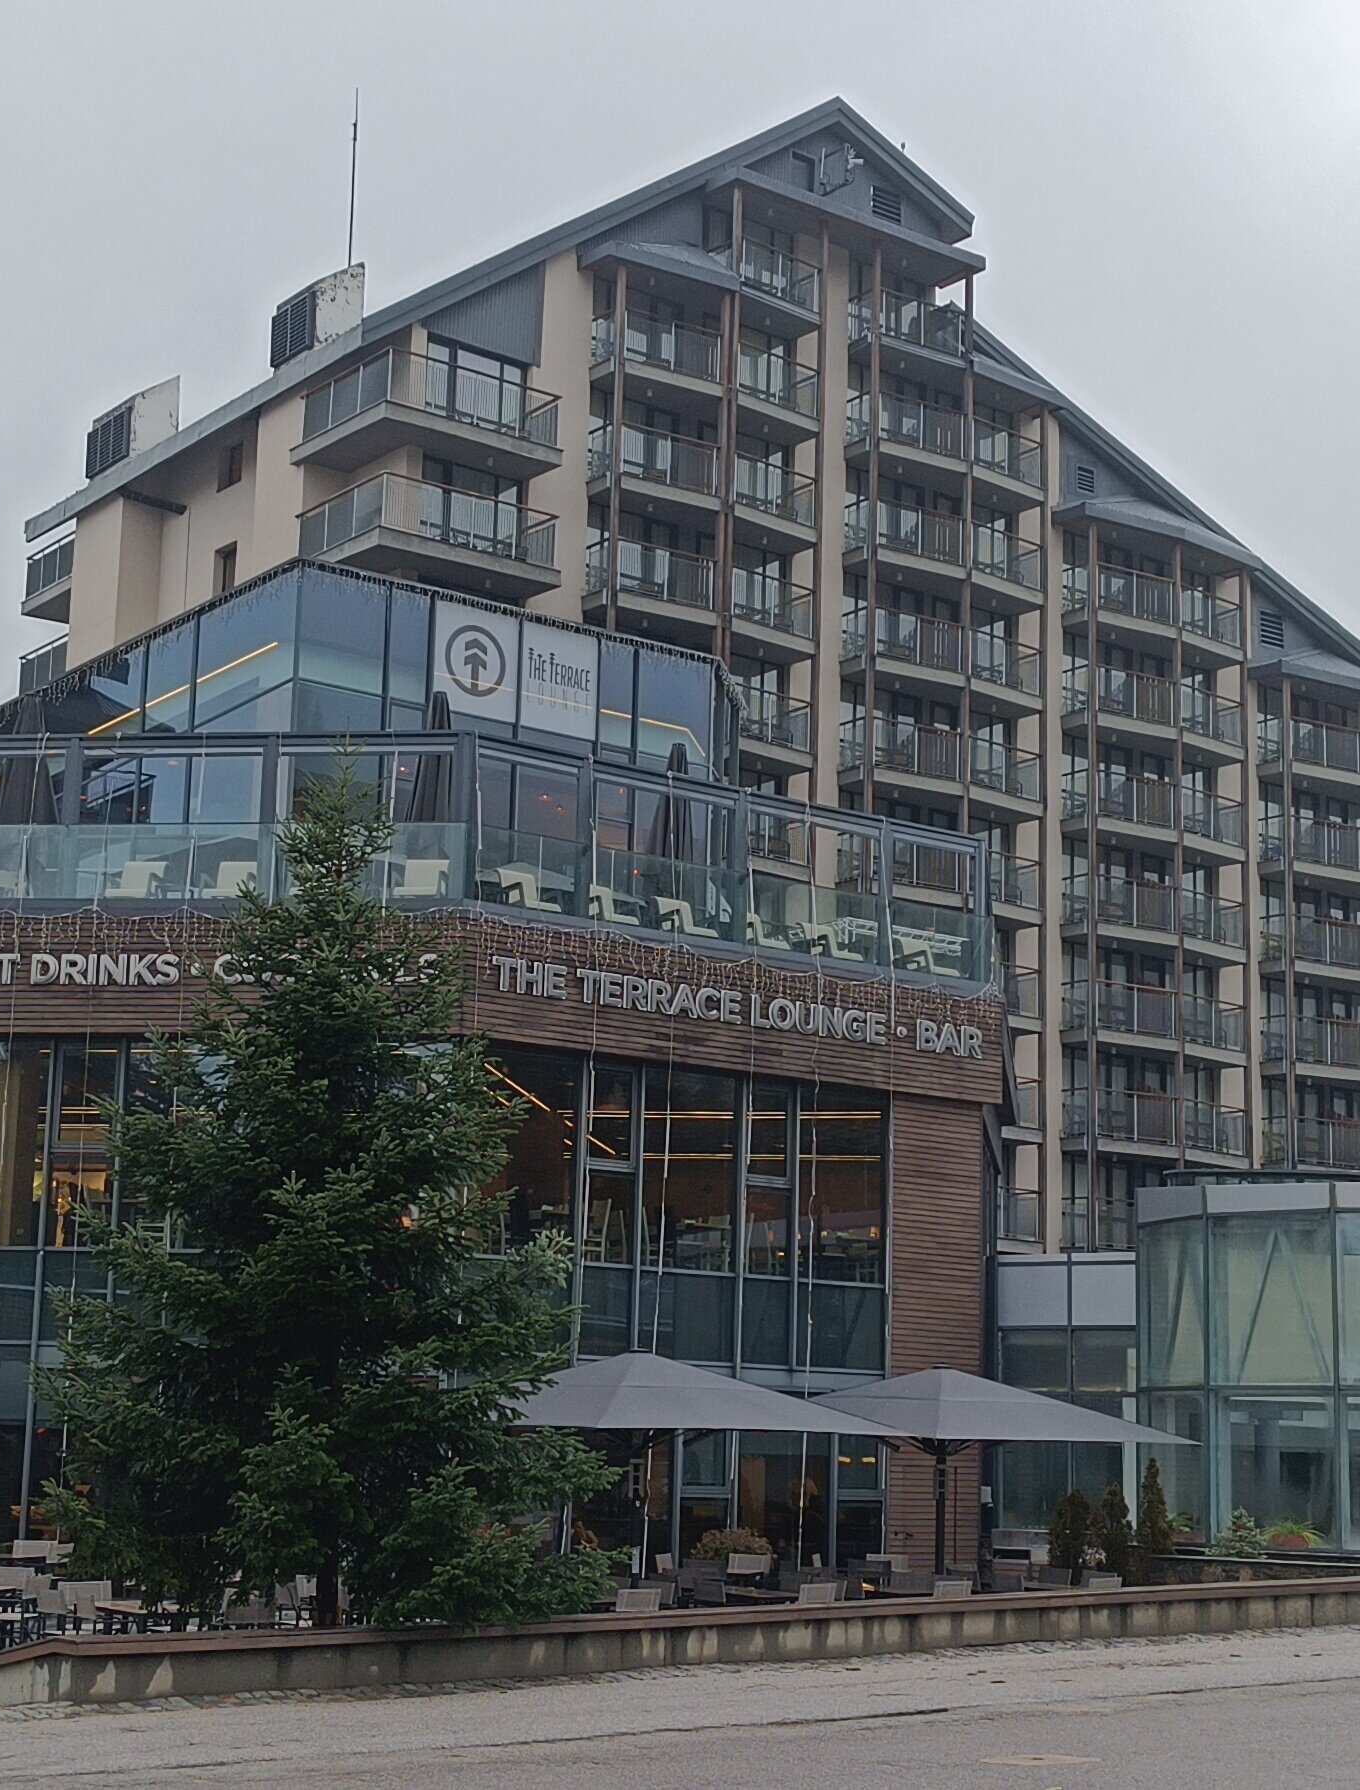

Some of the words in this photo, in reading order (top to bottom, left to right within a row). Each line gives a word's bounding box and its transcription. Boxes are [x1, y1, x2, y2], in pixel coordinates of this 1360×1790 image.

[528, 647, 548, 682] THE
[549, 652, 592, 692] TERRACE
[526, 679, 592, 717] LOUNGE
[30, 953, 180, 986] DRINKS
[492, 955, 568, 999] THE
[576, 968, 742, 1025] TERRACE
[750, 994, 888, 1046] LOUNGE
[916, 1018, 983, 1059] BAR
